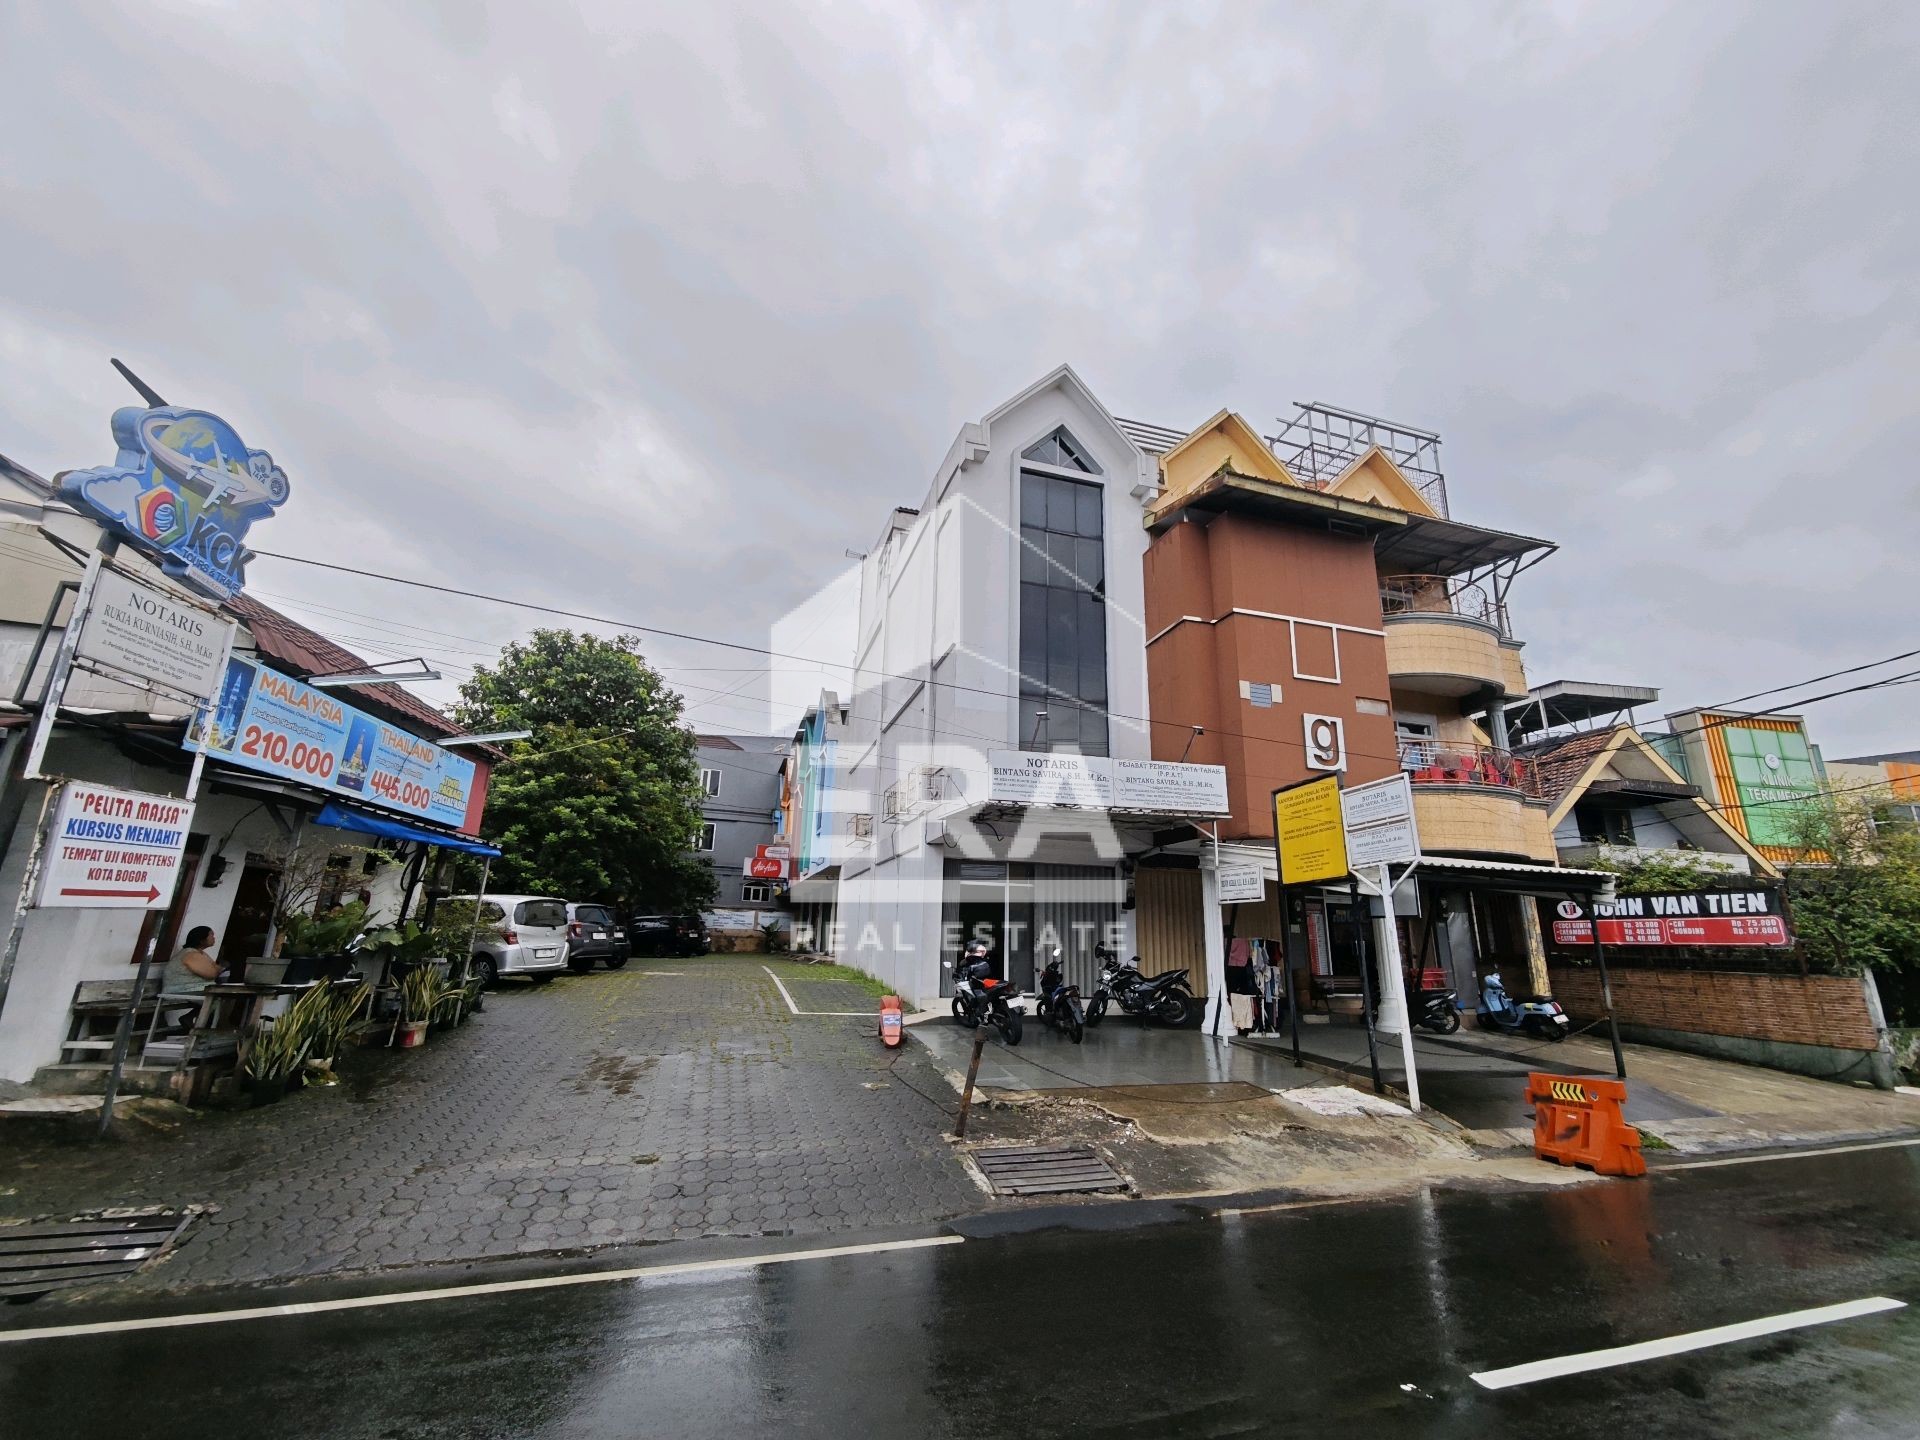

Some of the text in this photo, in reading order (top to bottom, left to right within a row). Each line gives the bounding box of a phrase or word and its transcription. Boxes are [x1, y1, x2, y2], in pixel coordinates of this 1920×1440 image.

[186, 513, 256, 587] KCK
[184, 549, 211, 574] TOURS
[216, 570, 243, 595] TRAVEL
[104, 604, 131, 625] RUKIA
[133, 616, 178, 647] KURNIASIH,
[128, 592, 204, 637] NOTARIS
[258, 671, 344, 725] MALAYSIA
[241, 725, 335, 778] 210.000
[381, 726, 434, 763] THAILAND
[993, 767, 1030, 777] BINTANG
[1033, 769, 1065, 780] SAVIRA,
[1027, 758, 1078, 770] NOTARIS
[1118, 761, 1147, 769] PEJABAT
[1149, 763, 1179, 771] PEMBUAT
[370, 769, 430, 810] 445.000
[1126, 777, 1155, 785] BINTANG
[1760, 774, 1795, 787] KLINIK
[1362, 791, 1387, 802] NOTARIS
[66, 818, 182, 846] KURSUS MENJAHIT
[62, 846, 176, 868] TEMPAT UJI KOMPETENSI
[87, 867, 148, 882] KOTA BOGOR
[1650, 896, 1698, 915] VAN
[1705, 892, 1768, 914] TIEN
[1731, 920, 1744, 928] Rp.
[1747, 919, 1777, 927] 75.000
[1733, 927, 1746, 935] Rp.
[1748, 926, 1779, 935] 67.000
